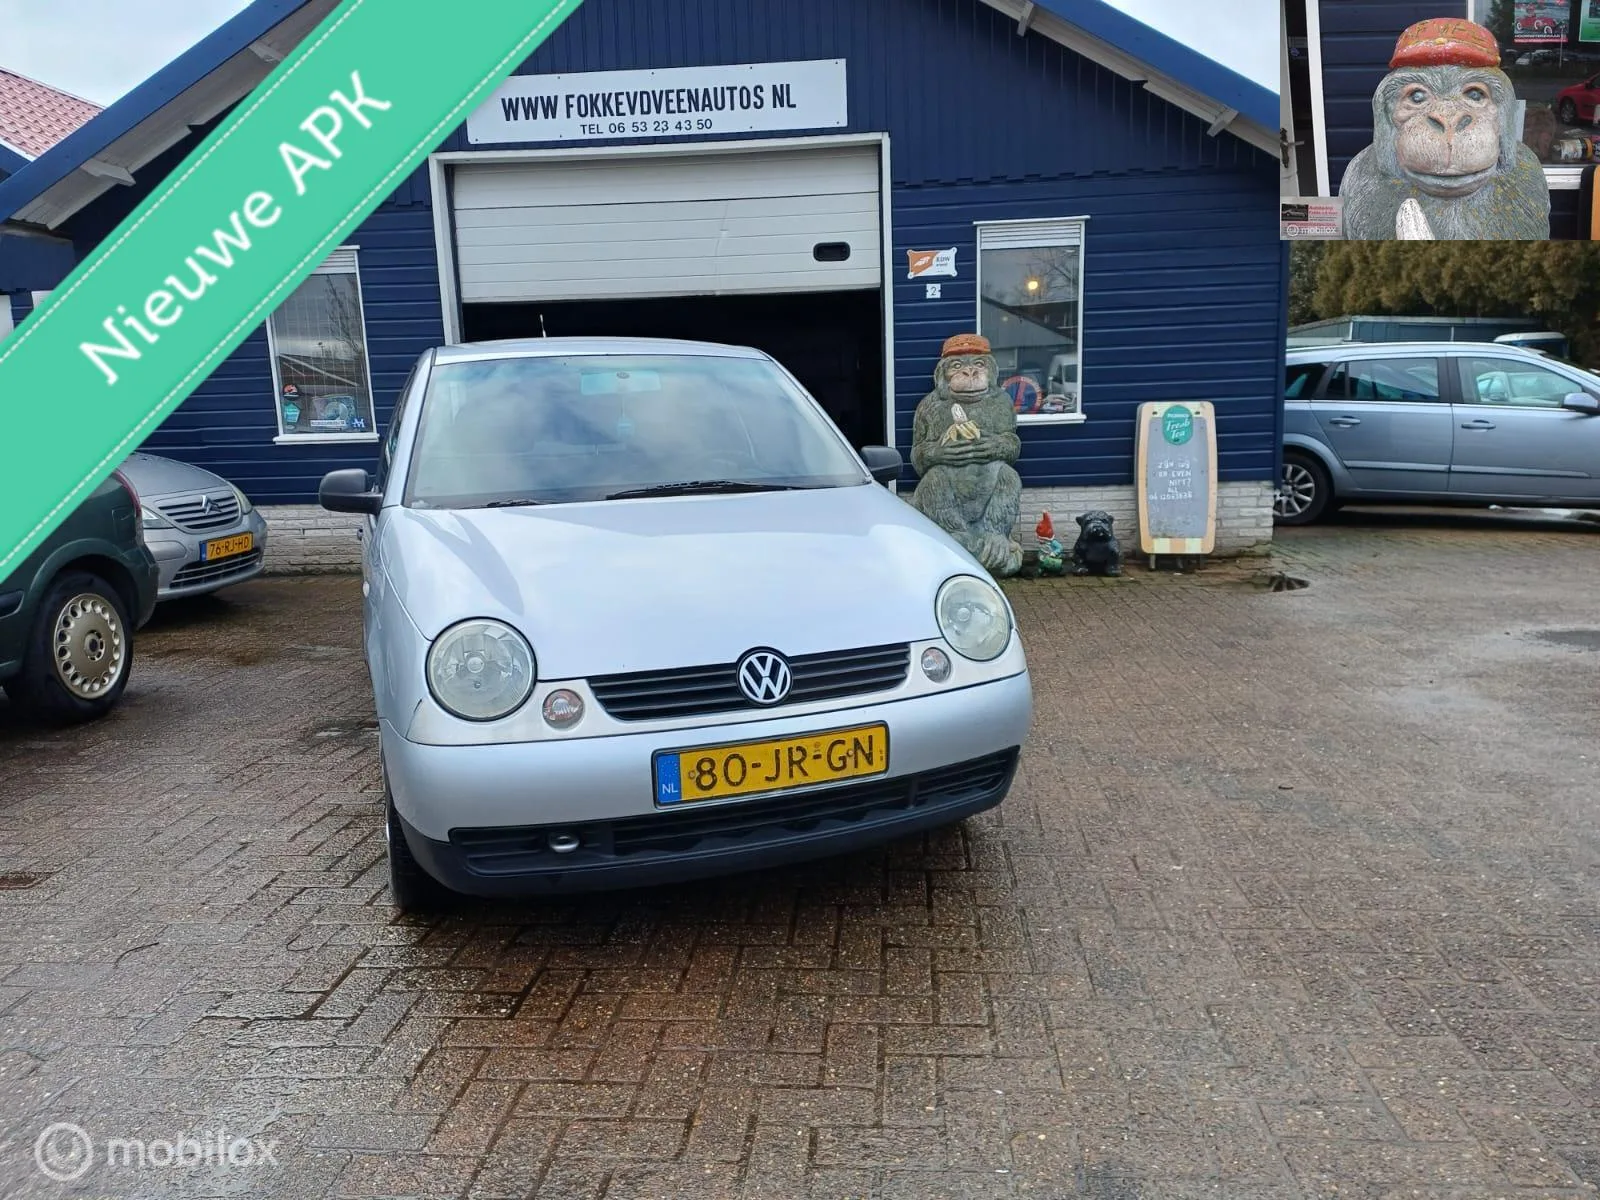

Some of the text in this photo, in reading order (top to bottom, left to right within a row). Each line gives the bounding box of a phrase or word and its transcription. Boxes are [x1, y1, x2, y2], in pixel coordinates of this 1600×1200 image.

[501, 83, 797, 122] WWW FOKKEVDVEENAUTOS NL
[580, 117, 713, 135] TEL 06 53 23 43 50
[930, 286, 937, 296] 2
[1171, 429, 1186, 439] Tea
[210, 536, 249, 557] 76-RJ-HD
[661, 734, 874, 794] NL 80-JR-GN
